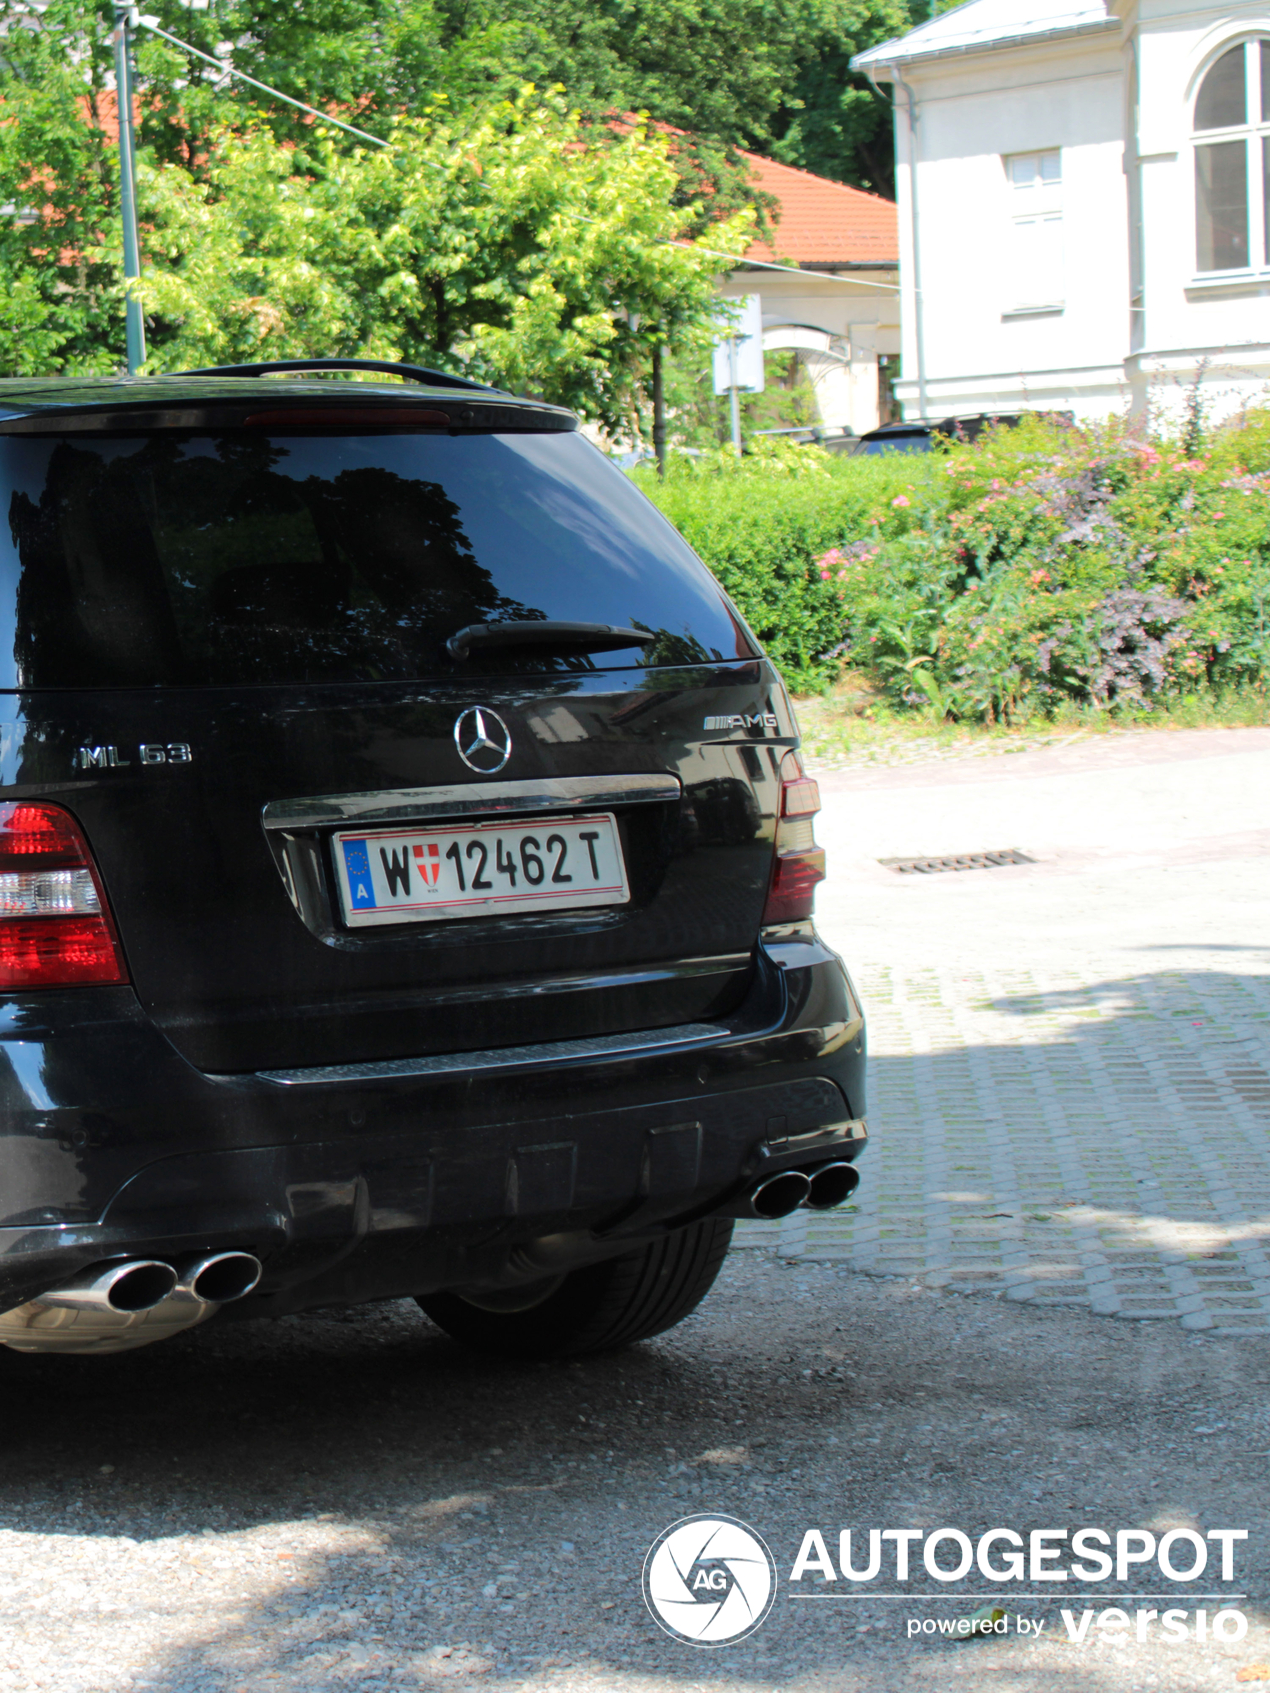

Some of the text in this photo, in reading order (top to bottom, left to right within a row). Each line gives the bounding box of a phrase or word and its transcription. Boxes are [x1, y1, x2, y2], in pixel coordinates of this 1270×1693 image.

[729, 713, 778, 729] AMG
[80, 743, 192, 769] ML 63
[379, 831, 599, 897] W 12462 T
[356, 884, 369, 899] A
